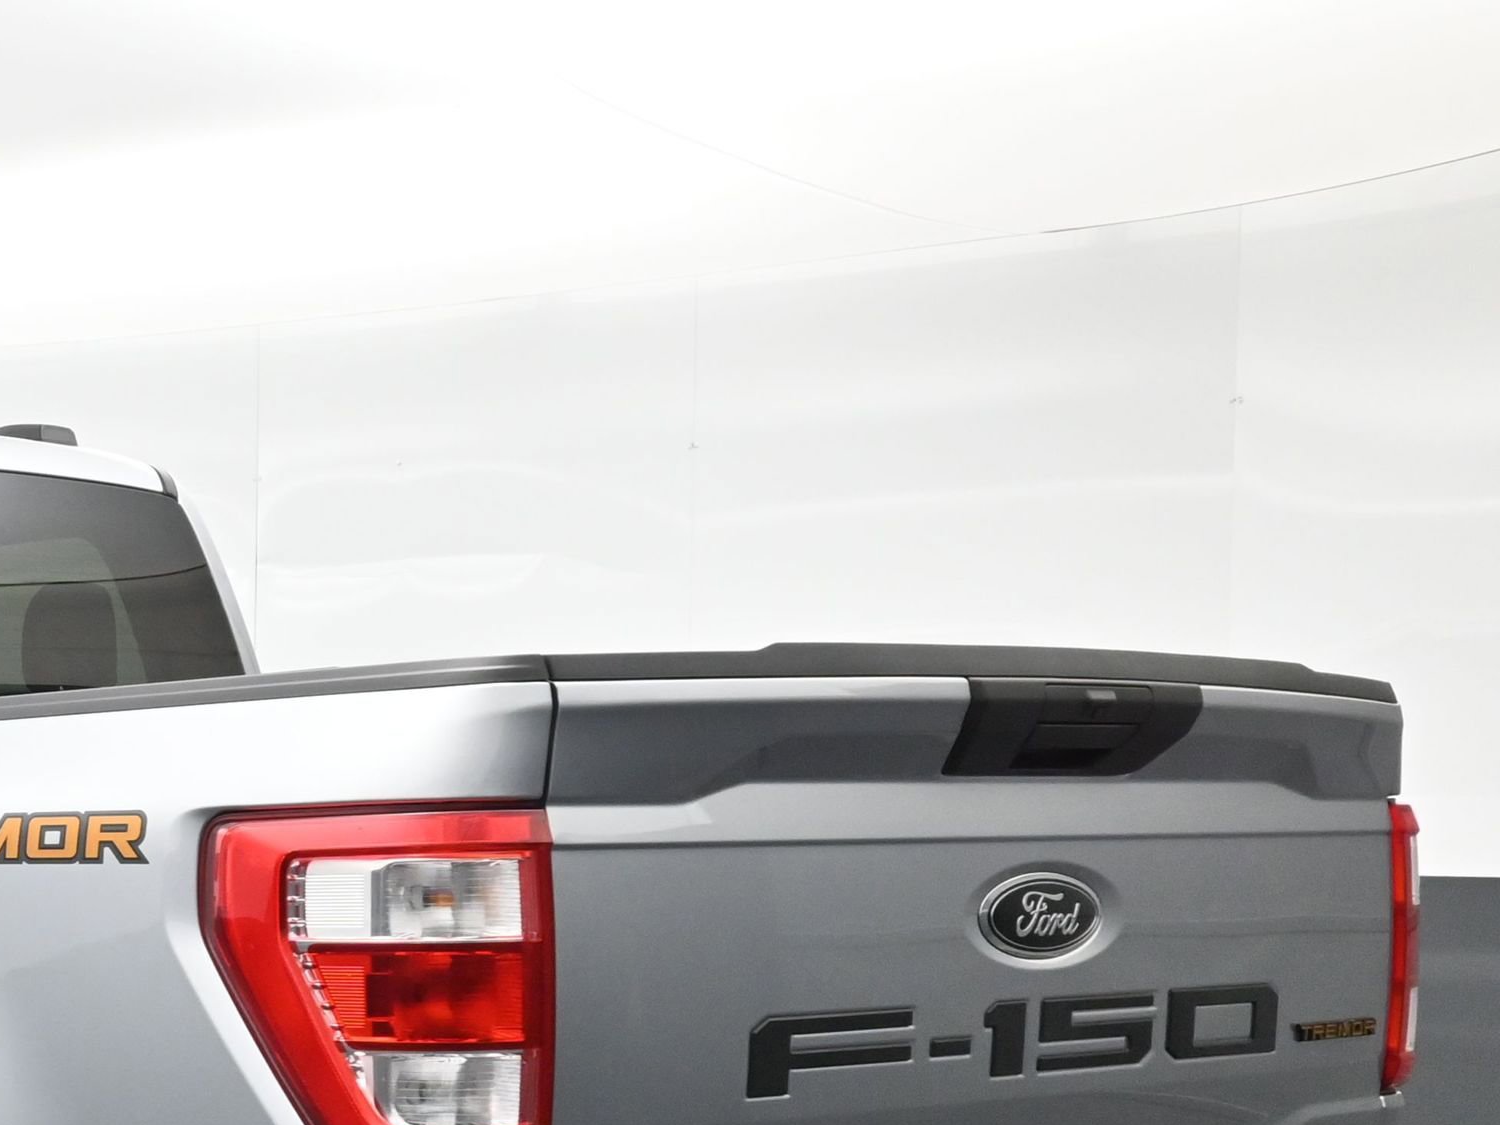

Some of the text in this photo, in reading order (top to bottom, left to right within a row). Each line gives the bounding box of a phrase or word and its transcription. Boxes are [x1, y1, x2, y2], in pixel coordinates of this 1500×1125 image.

[1016, 891, 1081, 937] Ford
[746, 982, 1279, 1100] F-150
[1296, 1017, 1377, 1042] TREMOR
